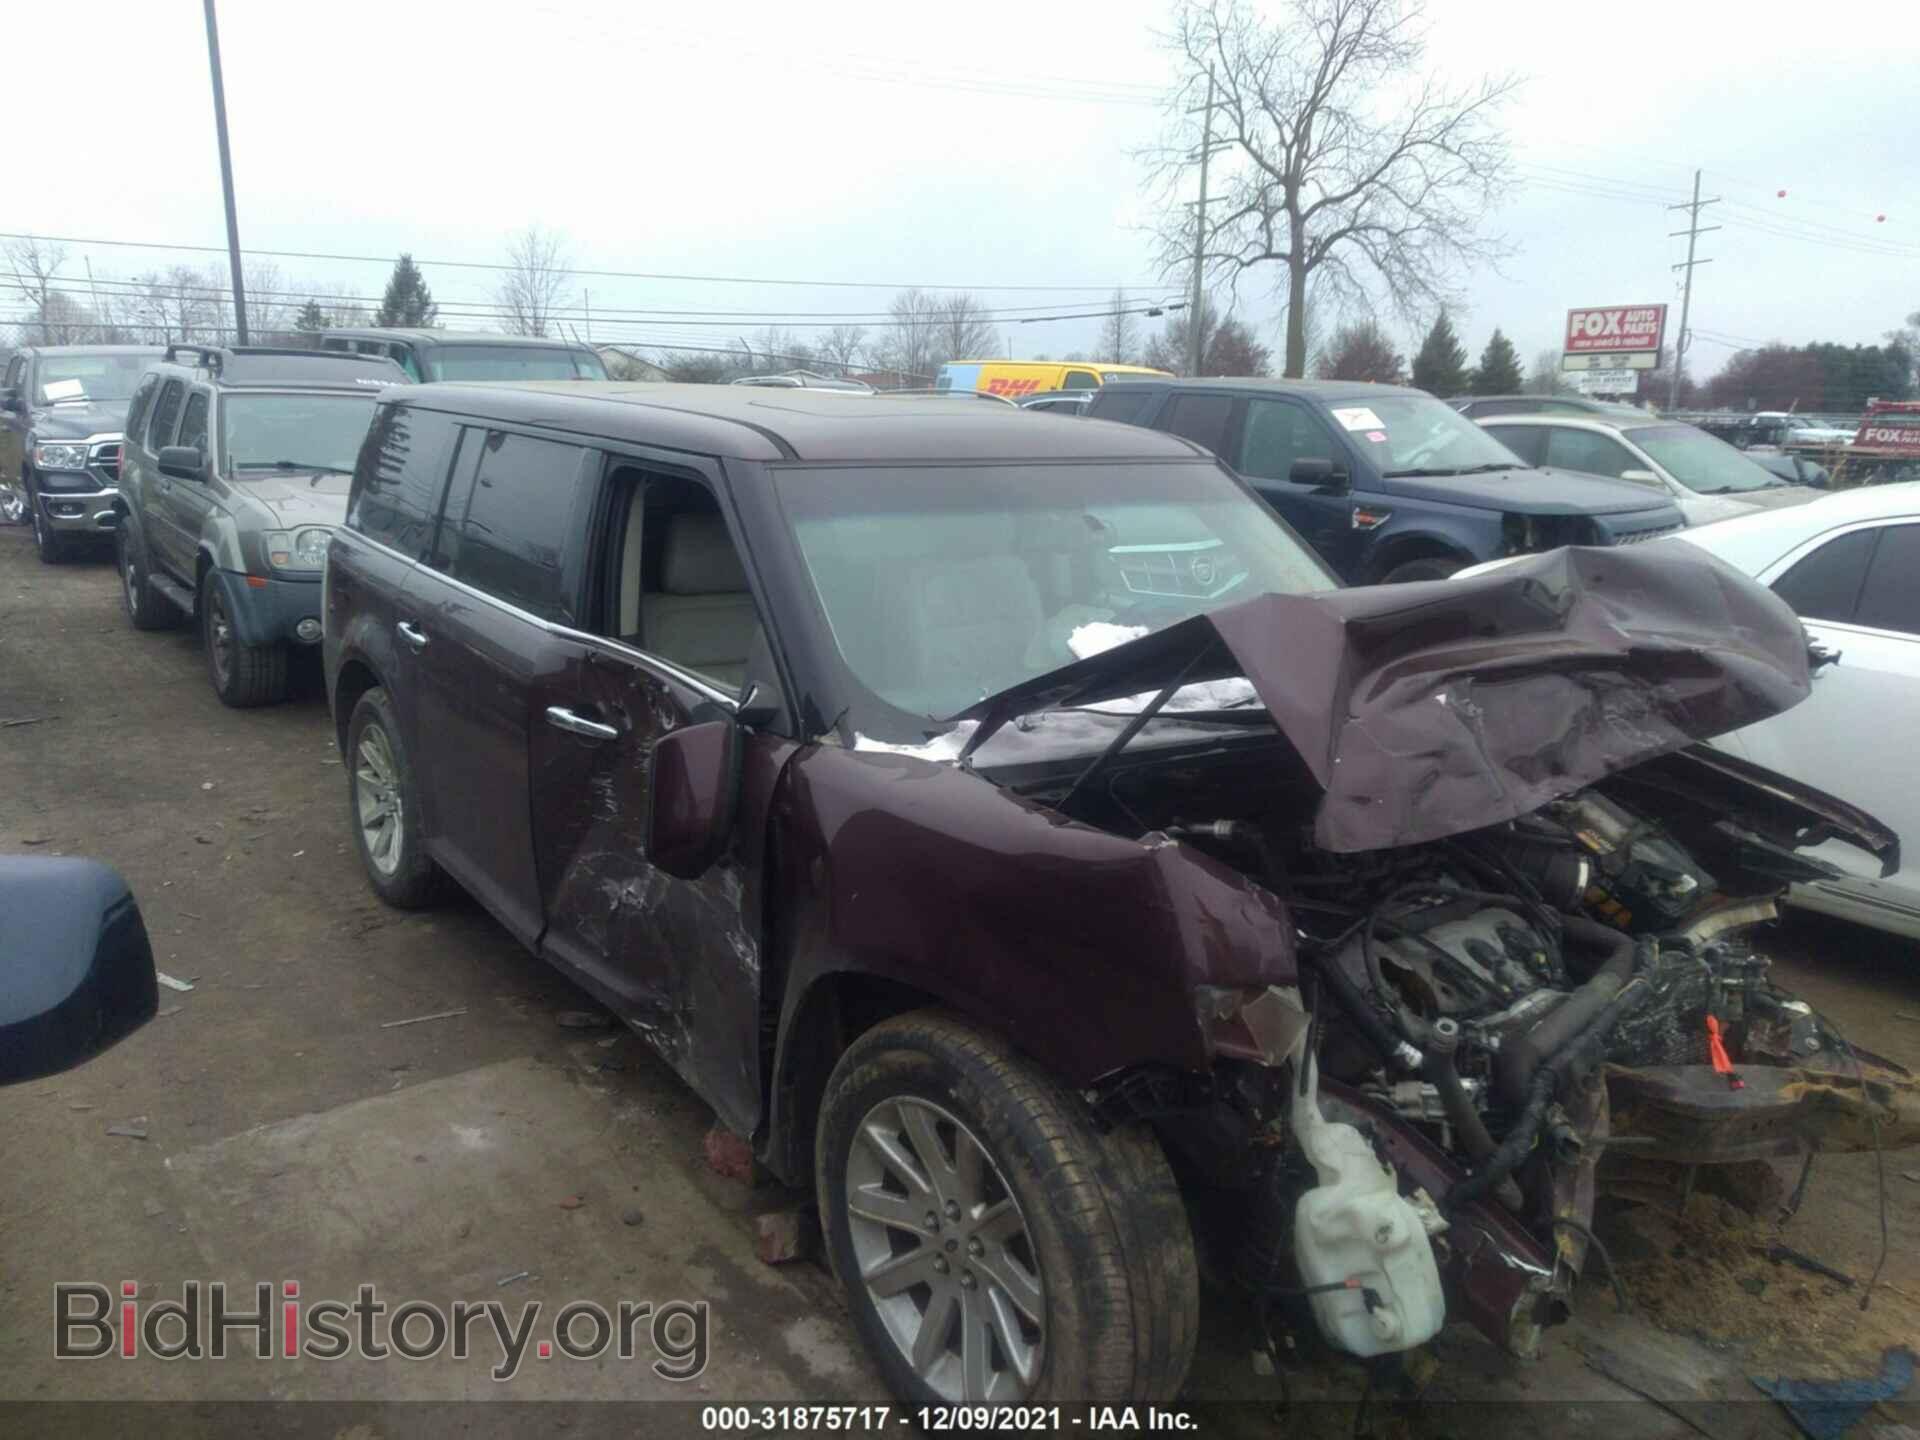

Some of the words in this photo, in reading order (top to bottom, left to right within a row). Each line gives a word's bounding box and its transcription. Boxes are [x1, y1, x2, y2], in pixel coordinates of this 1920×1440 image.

[1623, 309, 1656, 322] AUTO
[1571, 312, 1623, 337] FOX
[1622, 321, 1657, 335] PARTS
[1865, 428, 1904, 442] FOX
